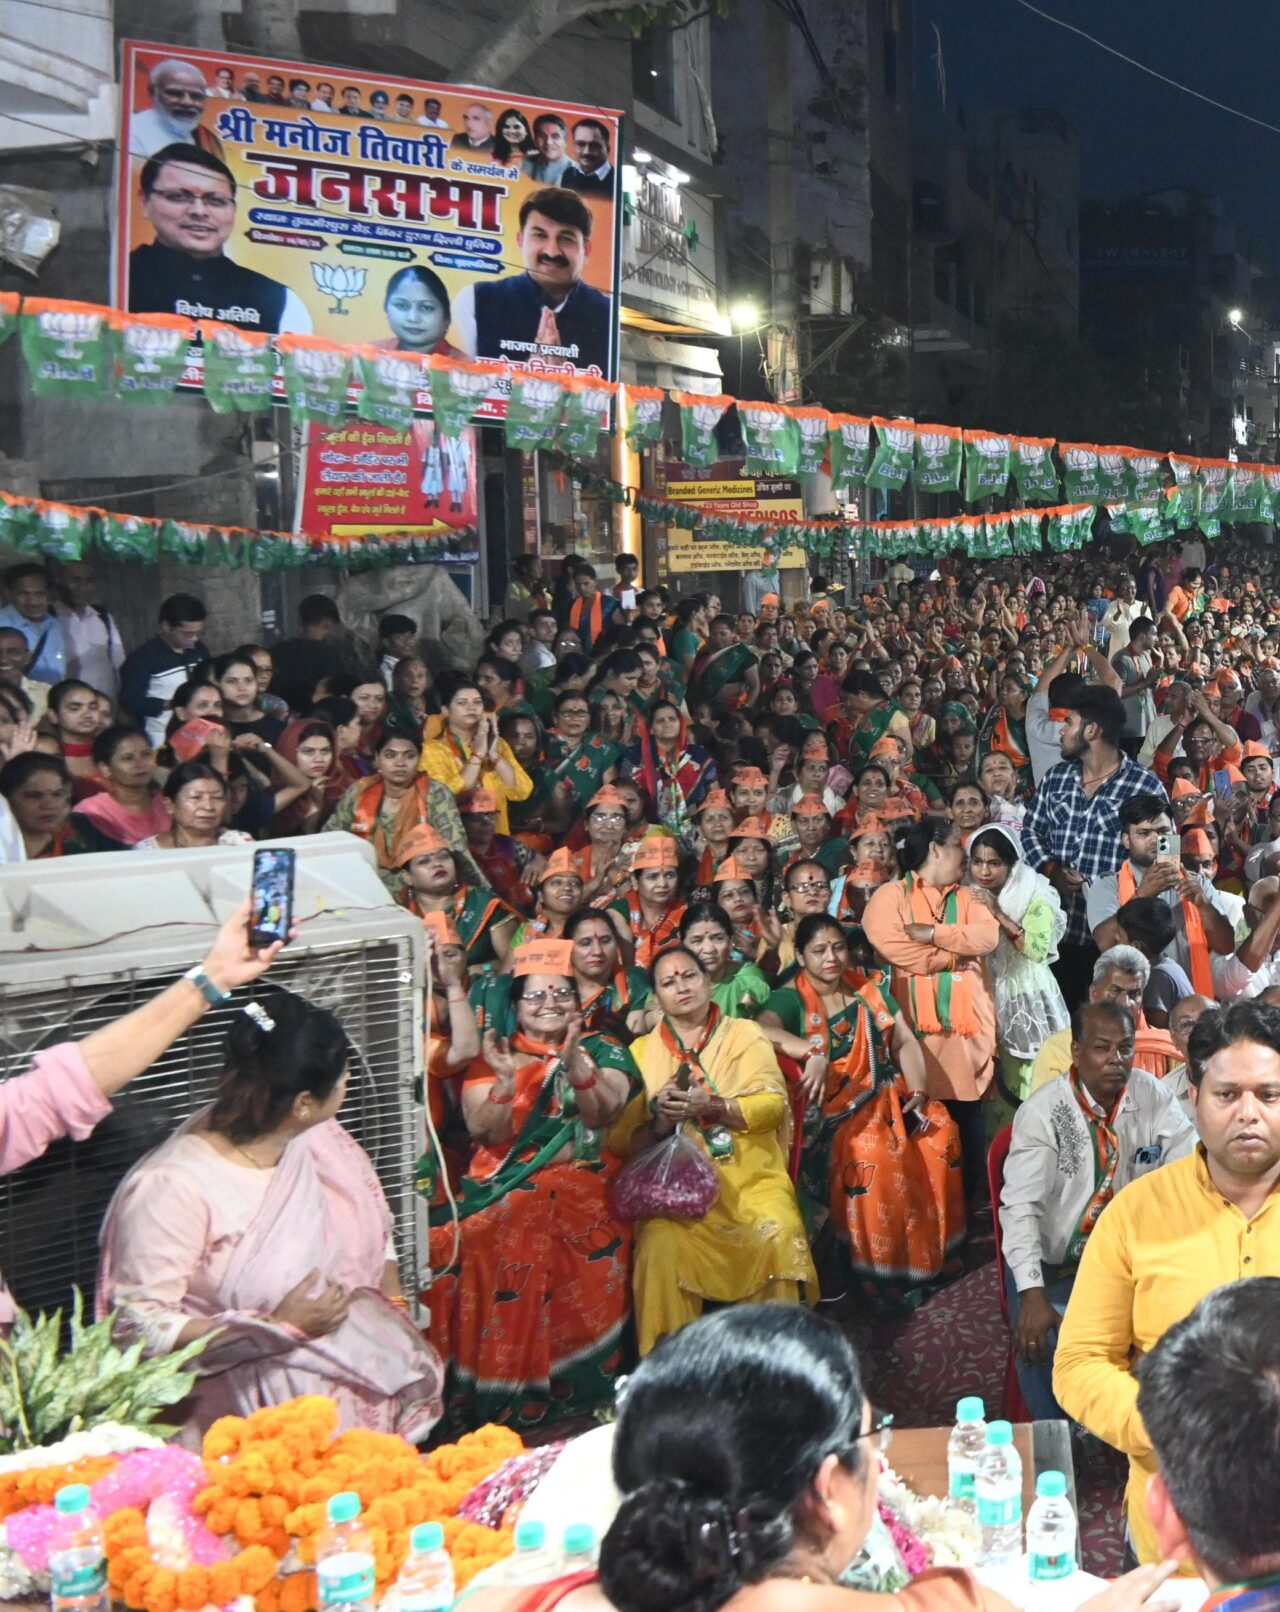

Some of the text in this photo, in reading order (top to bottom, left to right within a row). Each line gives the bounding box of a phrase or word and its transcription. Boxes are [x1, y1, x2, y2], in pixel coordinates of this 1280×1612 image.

[216, 107, 256, 145] श्री
[262, 117, 351, 157] मनोज
[357, 126, 448, 170] तिवारी
[450, 159, 464, 173] के
[466, 162, 505, 179] समर्थन
[244, 151, 507, 234] जनसभा
[175, 299, 261, 325] विशेष अतिथि
[500, 338, 580, 359] भाजपा प्रत्याशी
[668, 484, 753, 496] Branded Generic Medicines
[714, 501, 729, 509] Years
